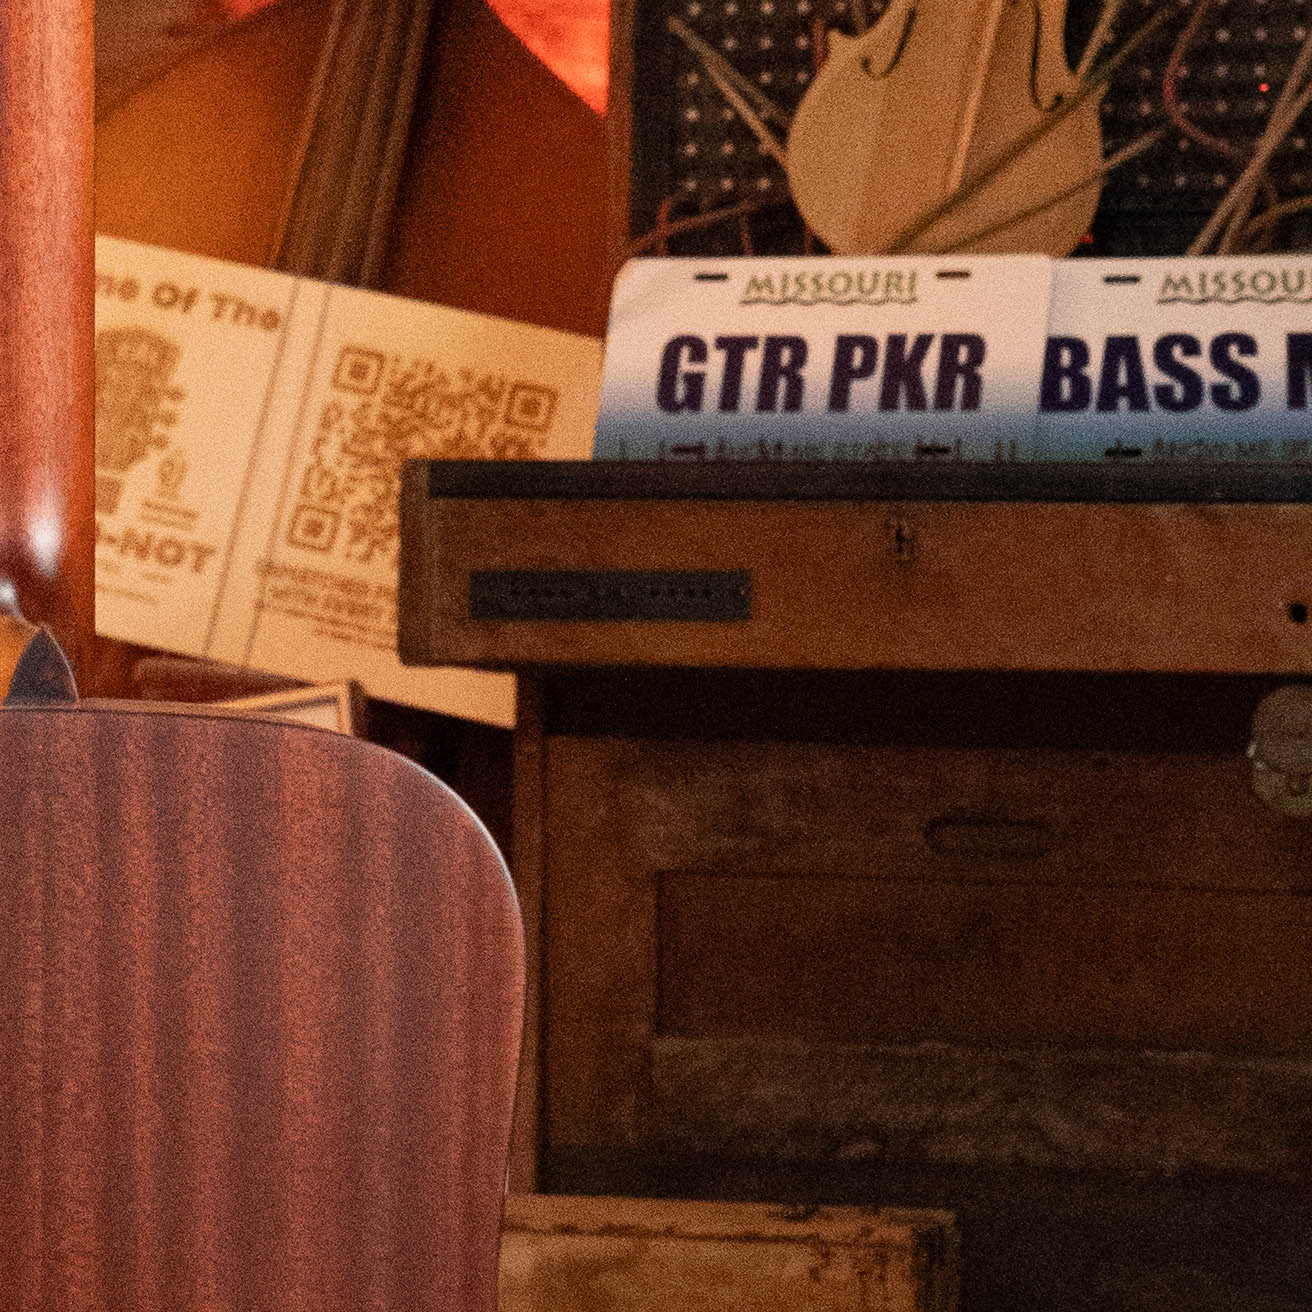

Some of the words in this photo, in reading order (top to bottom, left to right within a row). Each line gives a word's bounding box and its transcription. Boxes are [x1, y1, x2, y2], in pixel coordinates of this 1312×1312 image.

[210, 293, 282, 333] The
[743, 272, 918, 303] MISSOURI
[655, 333, 809, 415] GTR
[827, 332, 987, 415] PKR
[1038, 333, 1261, 415] BASS
